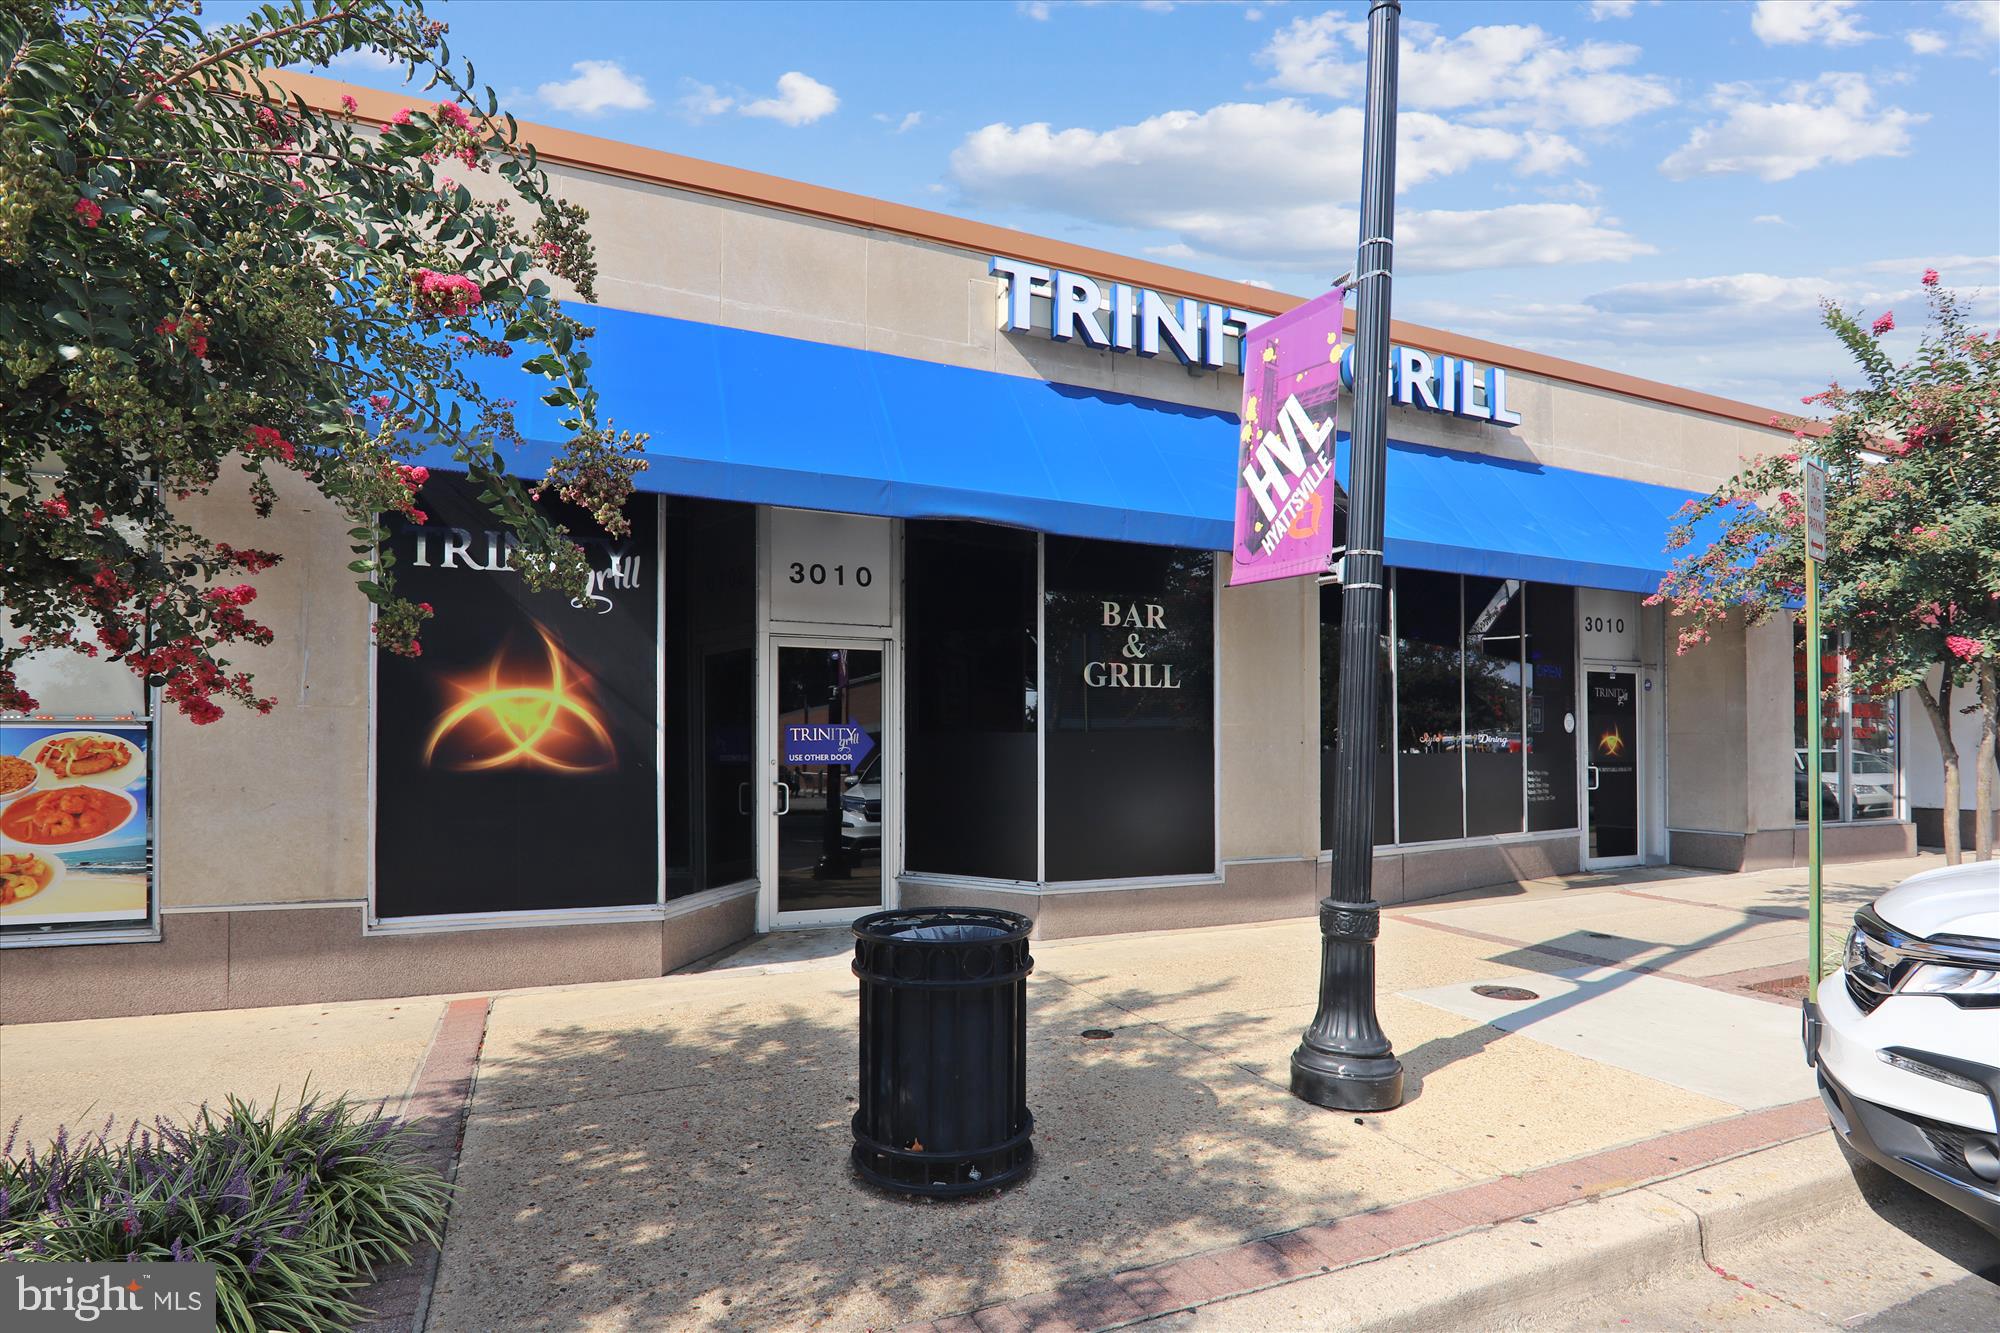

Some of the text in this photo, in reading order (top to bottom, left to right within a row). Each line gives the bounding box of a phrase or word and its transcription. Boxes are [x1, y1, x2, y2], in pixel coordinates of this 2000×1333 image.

[1242, 393, 1335, 522] HVL
[1261, 451, 1333, 557] HYATTSVILLE
[789, 562, 873, 587] 3010
[1101, 601, 1168, 630] BAR
[1584, 616, 1626, 634] 3010
[1122, 633, 1147, 659] &
[1083, 662, 1181, 689] GRILL
[1595, 687, 1627, 698] TRINITY
[789, 727, 858, 742] TRINITY
[838, 733, 859, 753] grill
[1478, 733, 1508, 747] Dining
